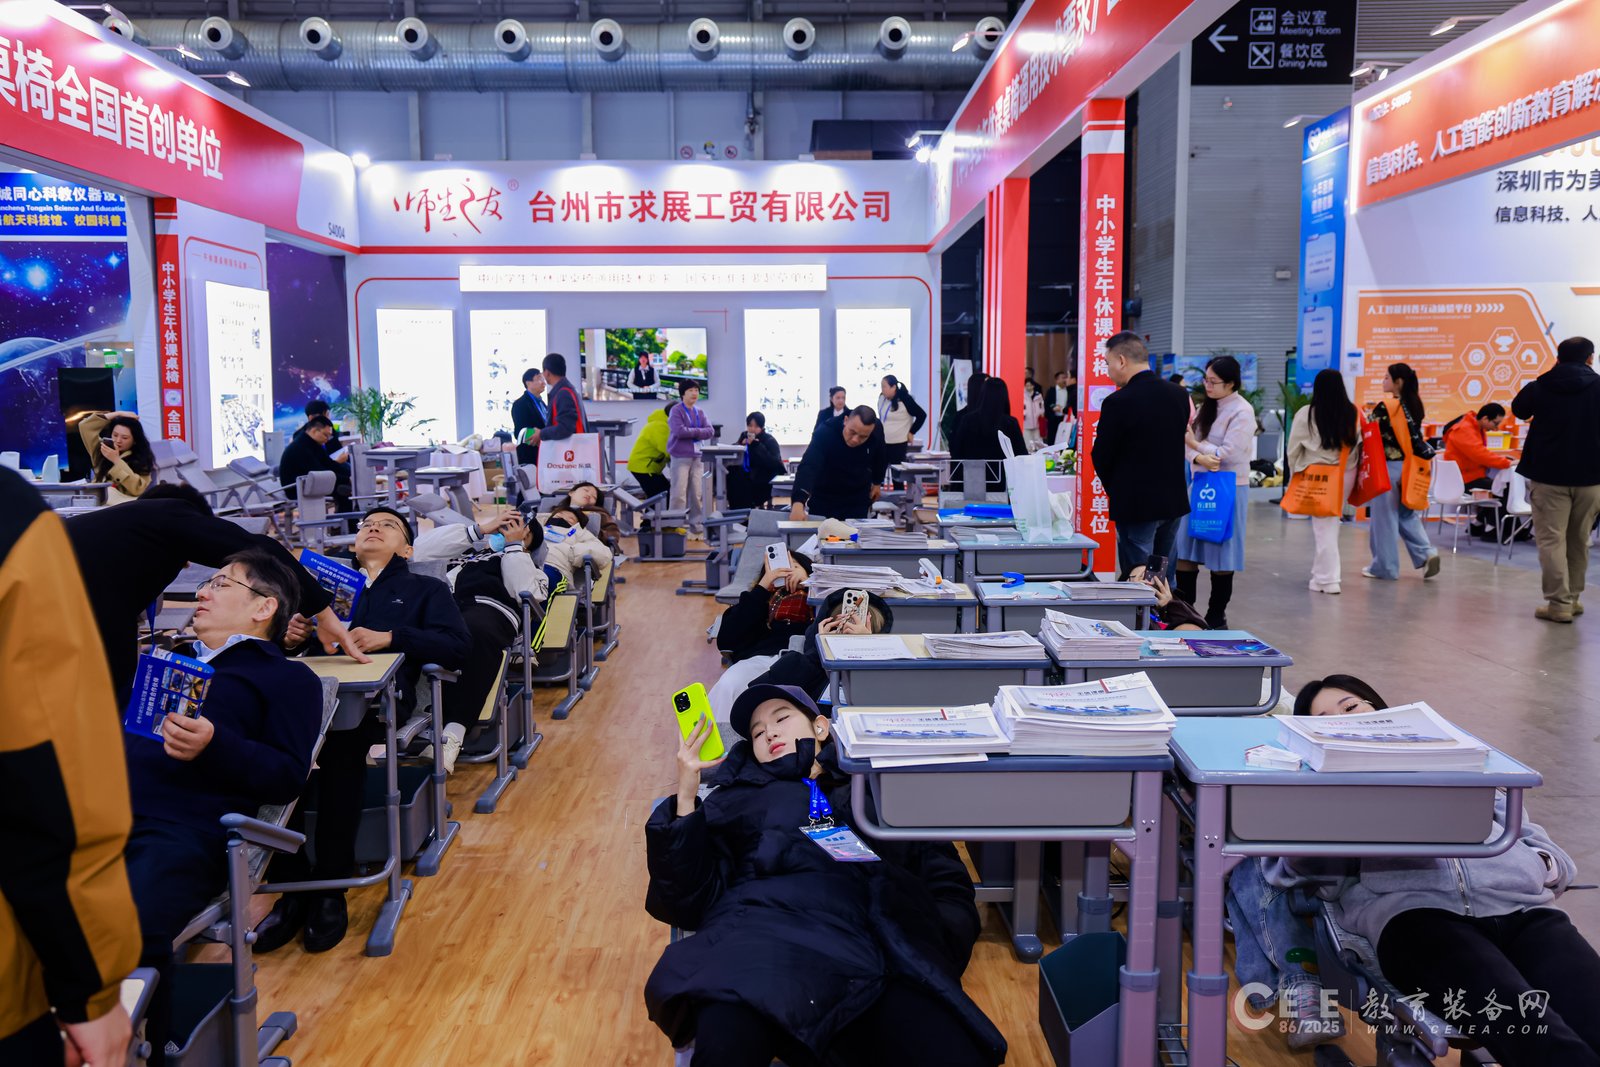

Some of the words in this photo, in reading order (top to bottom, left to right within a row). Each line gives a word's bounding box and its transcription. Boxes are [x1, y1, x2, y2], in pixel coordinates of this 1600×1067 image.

[1281, 10, 1327, 25] 会议室
[1280, 26, 1314, 35] Meeting
[1315, 26, 1341, 35] Room
[1280, 43, 1325, 58] 餐饮区
[1278, 59, 1305, 69] Dining
[1307, 59, 1328, 68] Area
[1366, 69, 1600, 186] 信息科技、人工智能创新教育解
[528, 190, 891, 223] 台州市求展工贸有限公司
[1495, 204, 1600, 224] 信息科技、人
[0, 214, 126, 226] 航天科技馆、校园科普、
[1093, 194, 1116, 376] 中小学生午休课桌椅
[161, 261, 179, 384] 中小学生午休课桌椅
[167, 409, 183, 441] 全国
